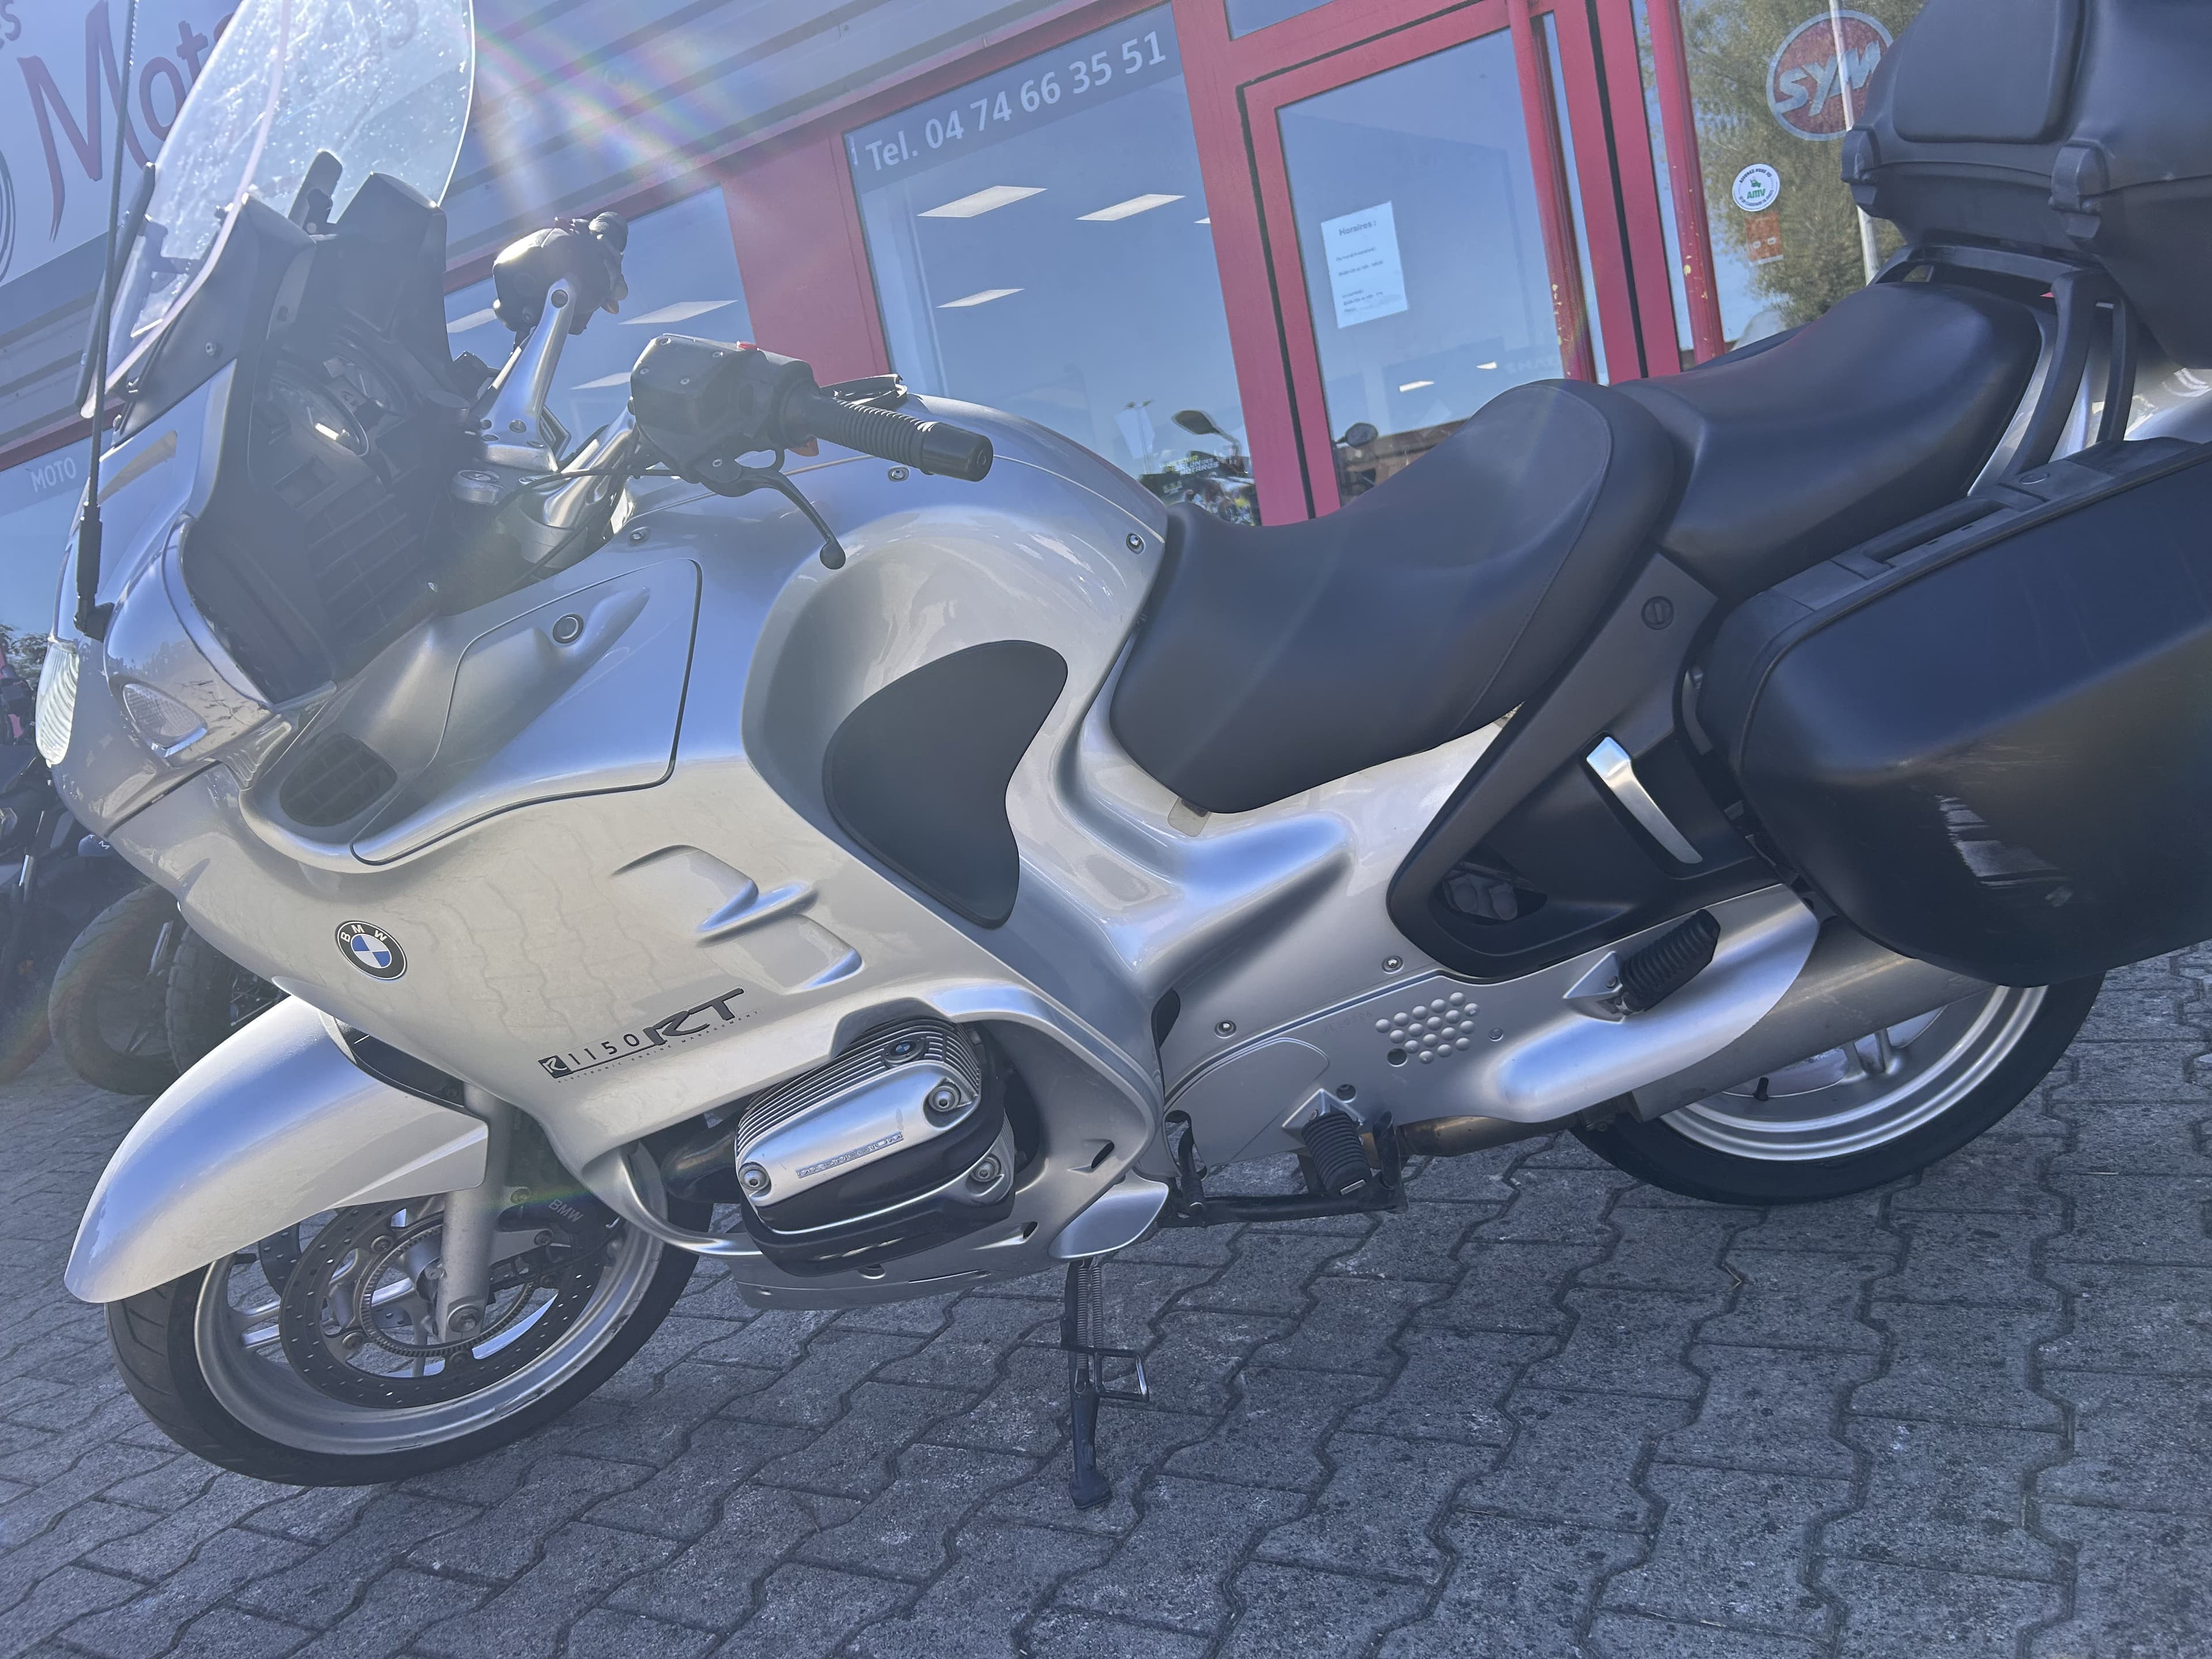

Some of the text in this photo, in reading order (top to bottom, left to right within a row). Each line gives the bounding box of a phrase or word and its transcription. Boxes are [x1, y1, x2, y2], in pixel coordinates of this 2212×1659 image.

[1775, 40, 1881, 116] SYM
[865, 31, 1166, 171] Tel. 04 74 66 35 51
[1747, 188, 1766, 199] AMV
[30, 457, 76, 493] MOTO
[340, 924, 387, 942] BMW
[569, 1033, 640, 1066] 1150
[643, 987, 745, 1046] RT
[558, 1062, 622, 1084] ELECTRONIC
[631, 1044, 672, 1061] ENGINE
[548, 1199, 584, 1222] BMW
